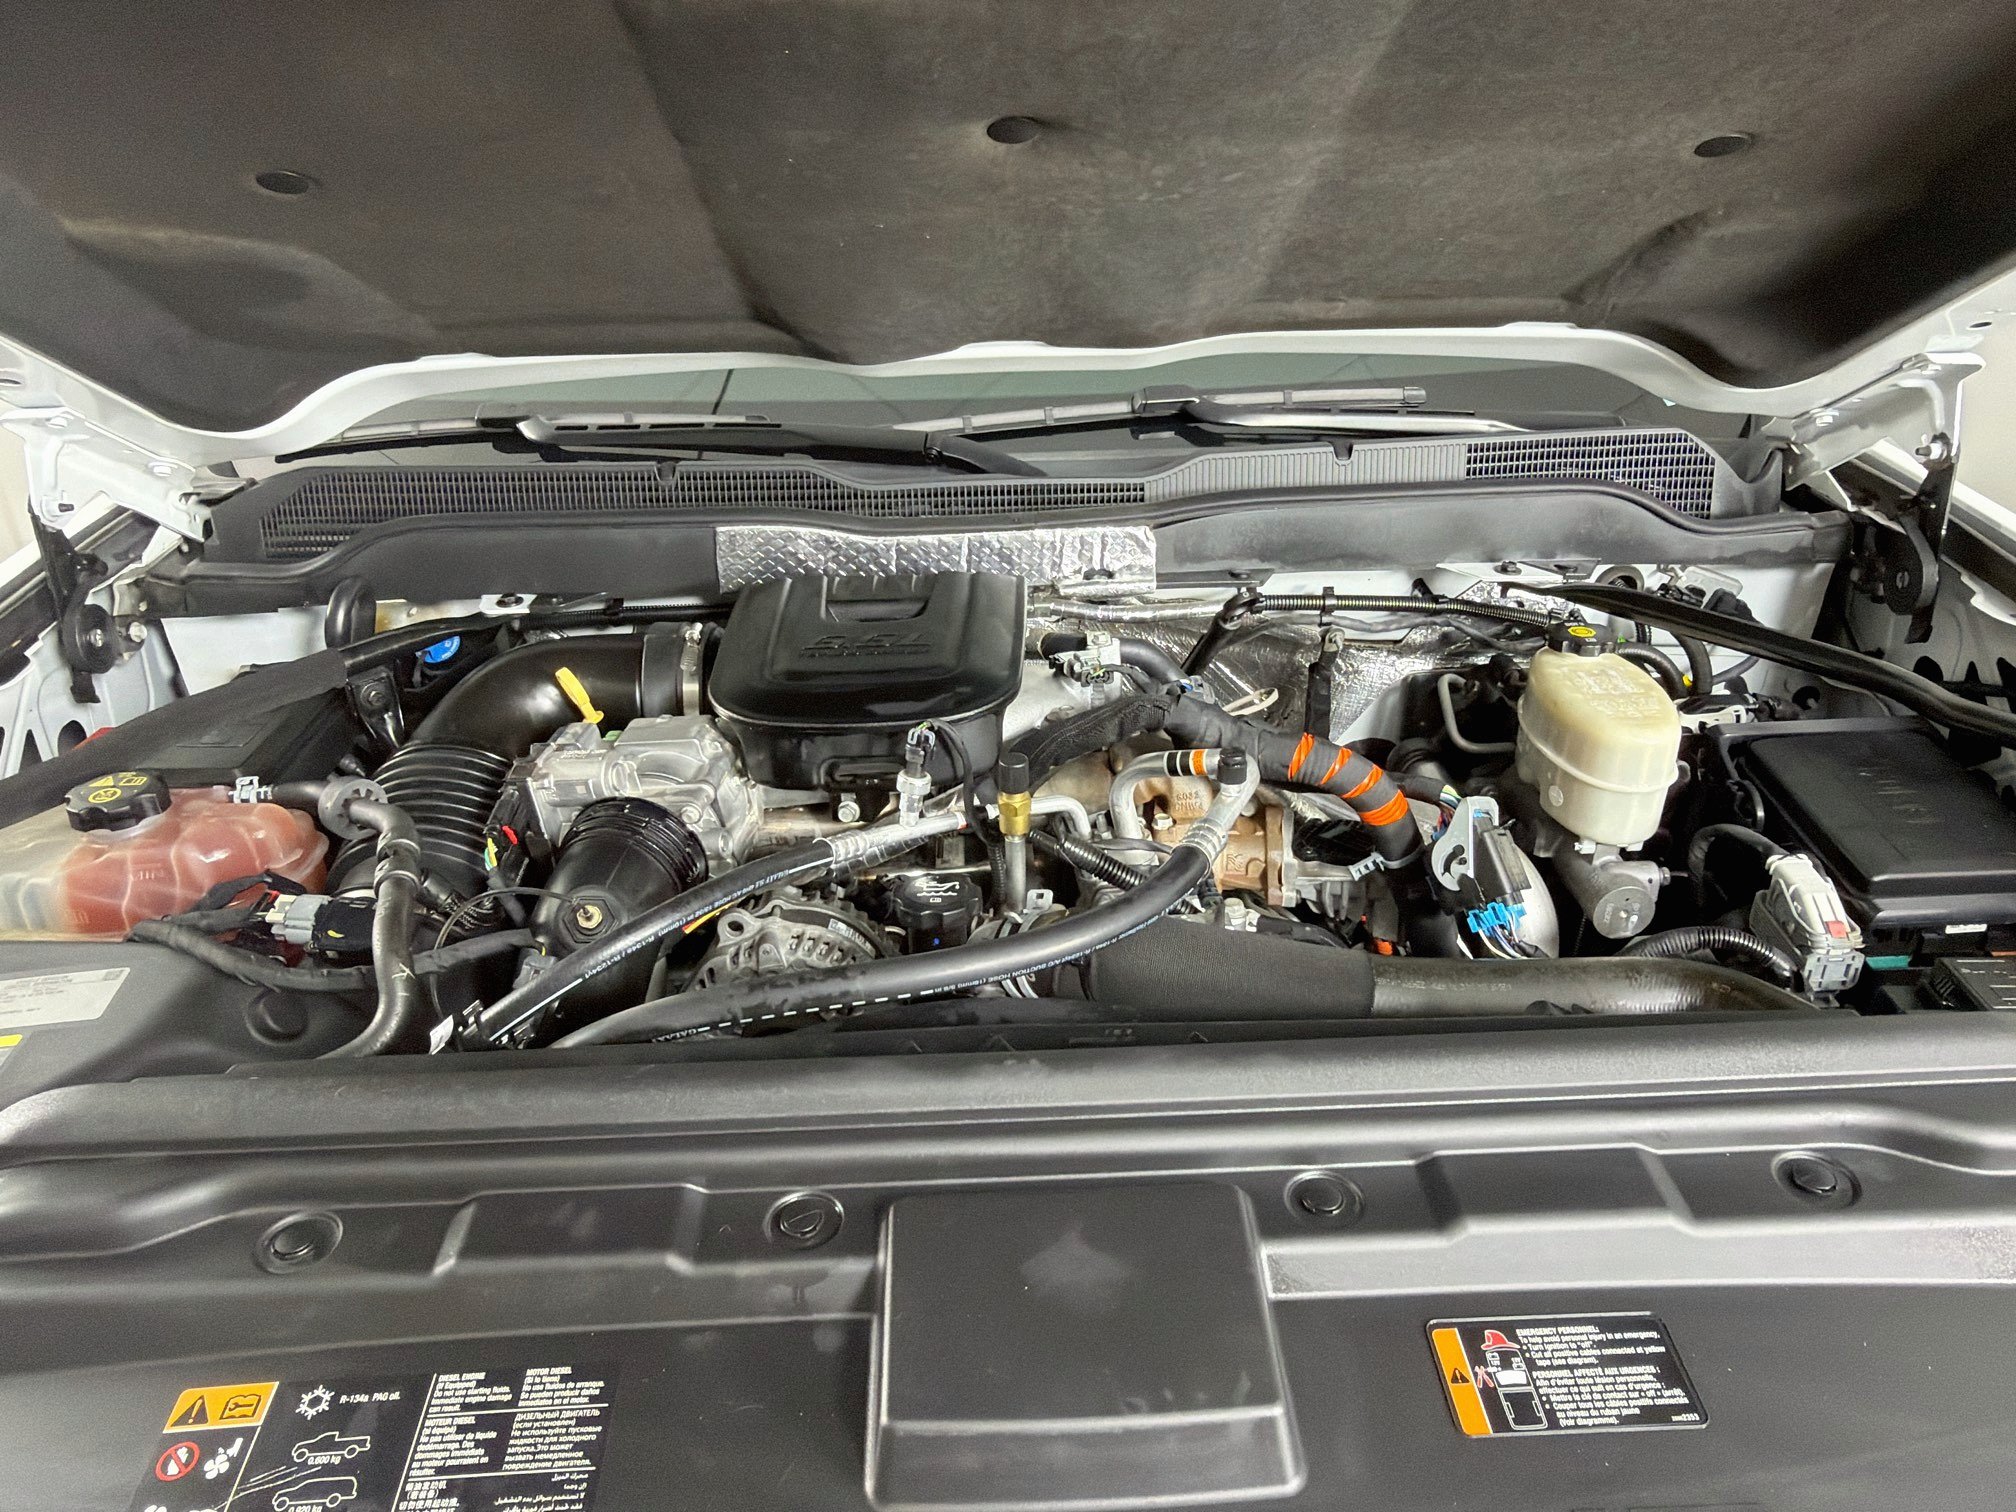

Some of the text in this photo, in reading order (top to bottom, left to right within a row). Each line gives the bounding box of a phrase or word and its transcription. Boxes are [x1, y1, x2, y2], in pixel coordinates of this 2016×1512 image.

[659, 917, 686, 936] (10mm)
[1012, 964, 1046, 977] SUCTION
[988, 973, 1011, 982] HOSE
[1516, 1326, 1599, 1336] EMERGENCY PERSONNEL:
[1560, 1334, 1588, 1342] personal
[1588, 1333, 1606, 1341] injury
[1544, 1342, 1569, 1351] ignition
[1552, 1350, 1578, 1358] positive
[1579, 1348, 1601, 1356] cables
[1602, 1346, 1636, 1354] connected
[1644, 1345, 1666, 1354] yellow
[1535, 1359, 1551, 1367] tape
[1552, 1358, 1566, 1366] (see
[526, 1366, 572, 1376] MOTOR DIESEL
[1532, 1370, 1573, 1379] PERSONNEL
[1574, 1366, 1604, 1376] AFFECTÉ
[1604, 1367, 1619, 1375] AUX
[438, 1372, 486, 1382] DIESEL ENGINE
[1594, 1376, 1615, 1384] lésion
[444, 1381, 476, 1390] Equipped)
[545, 1382, 565, 1390] fluidos
[1539, 1386, 1568, 1394] effectuer
[1579, 1385, 1591, 1393] qui
[1591, 1384, 1605, 1392] suit
[340, 1394, 369, 1404] R-134a
[372, 1392, 389, 1402] PAG
[433, 1390, 442, 1398] Do
[467, 1387, 491, 1395] starting
[530, 1391, 553, 1400] pueden
[553, 1389, 580, 1398] producir
[1550, 1394, 1572, 1402] Mettre
[1581, 1392, 1592, 1400] clé
[1602, 1391, 1628, 1399] contact
[431, 1394, 512, 1405] Immediate engine damage
[1552, 1396, 1689, 1410] Couper tous les câbles positifs connectés
[514, 1408, 600, 1421] ДИЗЕЛЬНЫЙ ДВИГАТЕЛЬ
[1620, 1407, 1640, 1416] jaune
[424, 1416, 476, 1427] MOTEUR DIESEL
[512, 1418, 576, 1429] (если установлен)
[1559, 1418, 1575, 1427] (Voir
[511, 1425, 602, 1437] Не используйте пусковые
[429, 1435, 442, 1443] pas
[443, 1433, 465, 1441] utiliser
[465, 1432, 475, 1440] de
[475, 1431, 497, 1440] liquide
[508, 1434, 597, 1445] жидкости для холодного
[461, 1440, 475, 1448] Des
[330, 1455, 342, 1465] kg
[414, 1451, 450, 1460] dommages
[504, 1451, 584, 1462] вызвать немедленное
[421, 1459, 445, 1467] moteur
[445, 1457, 479, 1467] pourraient
[480, 1456, 489, 1464] en
[502, 1459, 591, 1470] повреждение двигателя.
